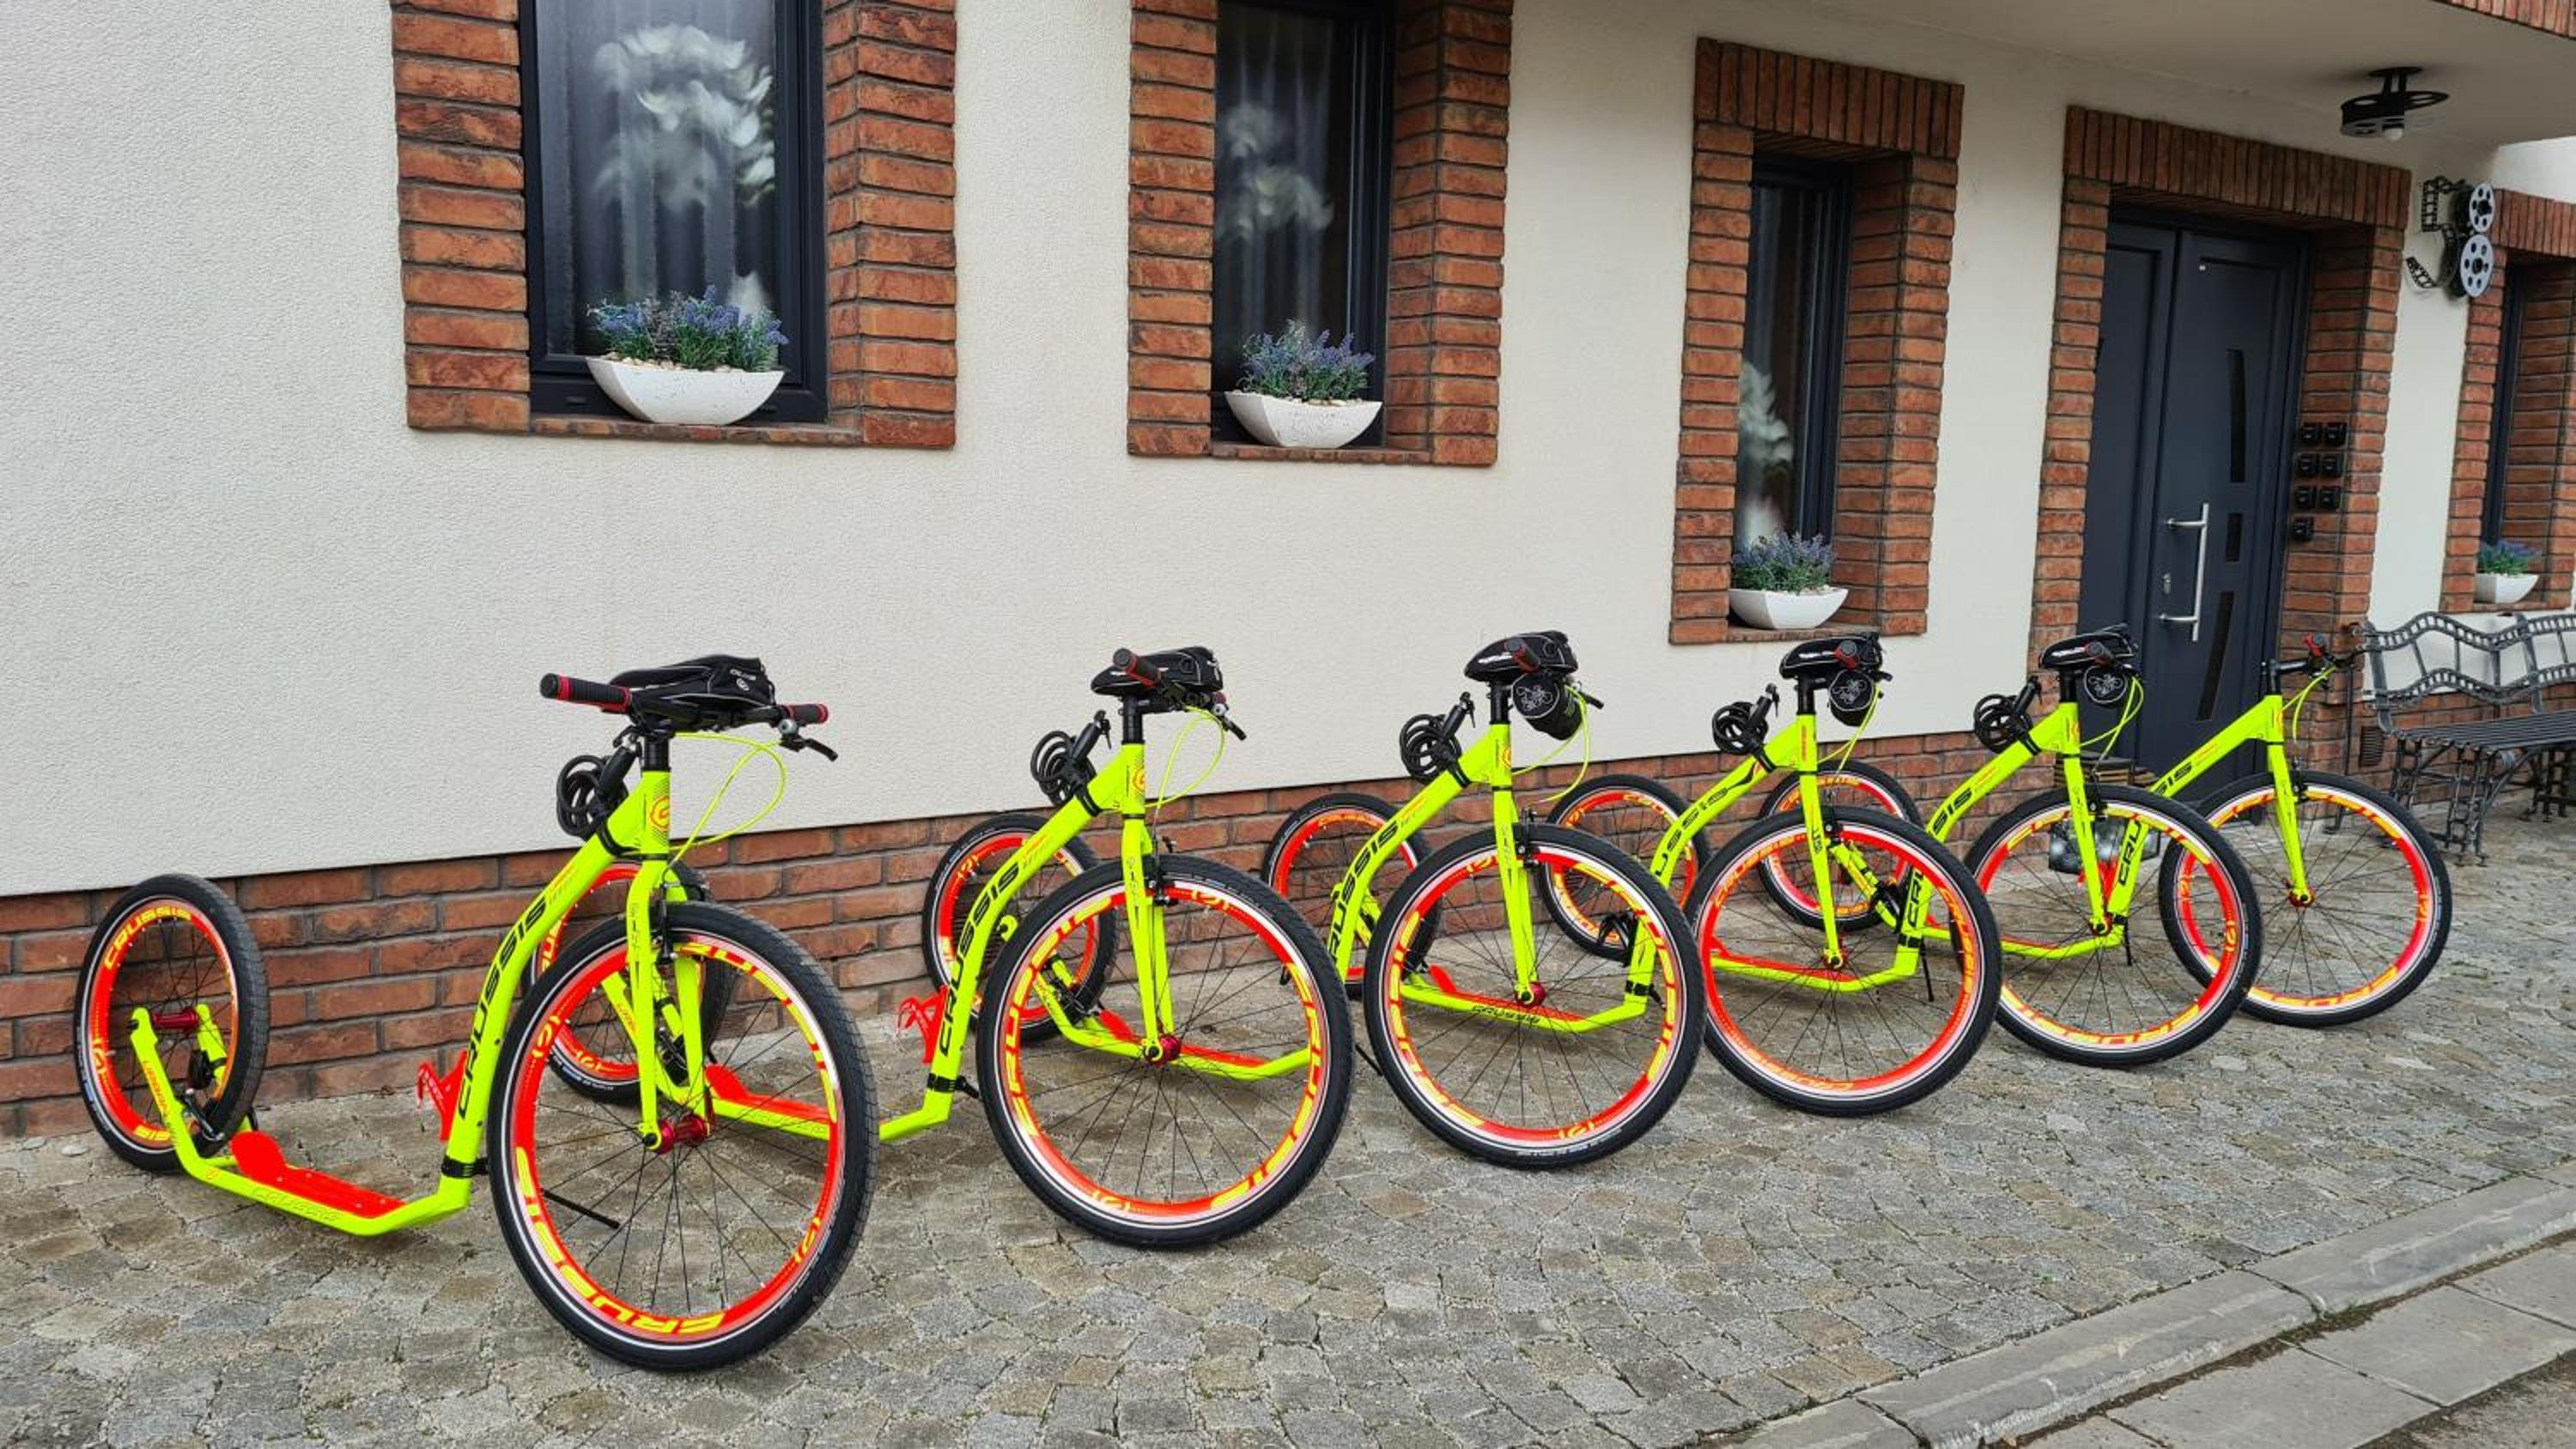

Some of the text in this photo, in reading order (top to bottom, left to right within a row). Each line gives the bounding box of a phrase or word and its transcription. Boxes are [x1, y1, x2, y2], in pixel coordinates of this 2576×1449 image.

[1329, 821, 1399, 962] RUSSIS
[1655, 787, 1729, 876] USSIS
[2007, 807, 2213, 865] CRSSIS
[103, 906, 192, 969] CRUSSIS
[459, 895, 547, 1119] CRUSSIS
[677, 942, 838, 1123] RUSSIS
[939, 861, 1019, 1057] CRUSSIS
[1005, 896, 1112, 1137] CRUSSIS
[1389, 910, 1485, 1127] CRUSSIS
[1573, 862, 1677, 1082] CRUSSIS
[1209, 962, 1321, 1209] CRUSSIS
[515, 1147, 727, 1334] CRUSSIS
